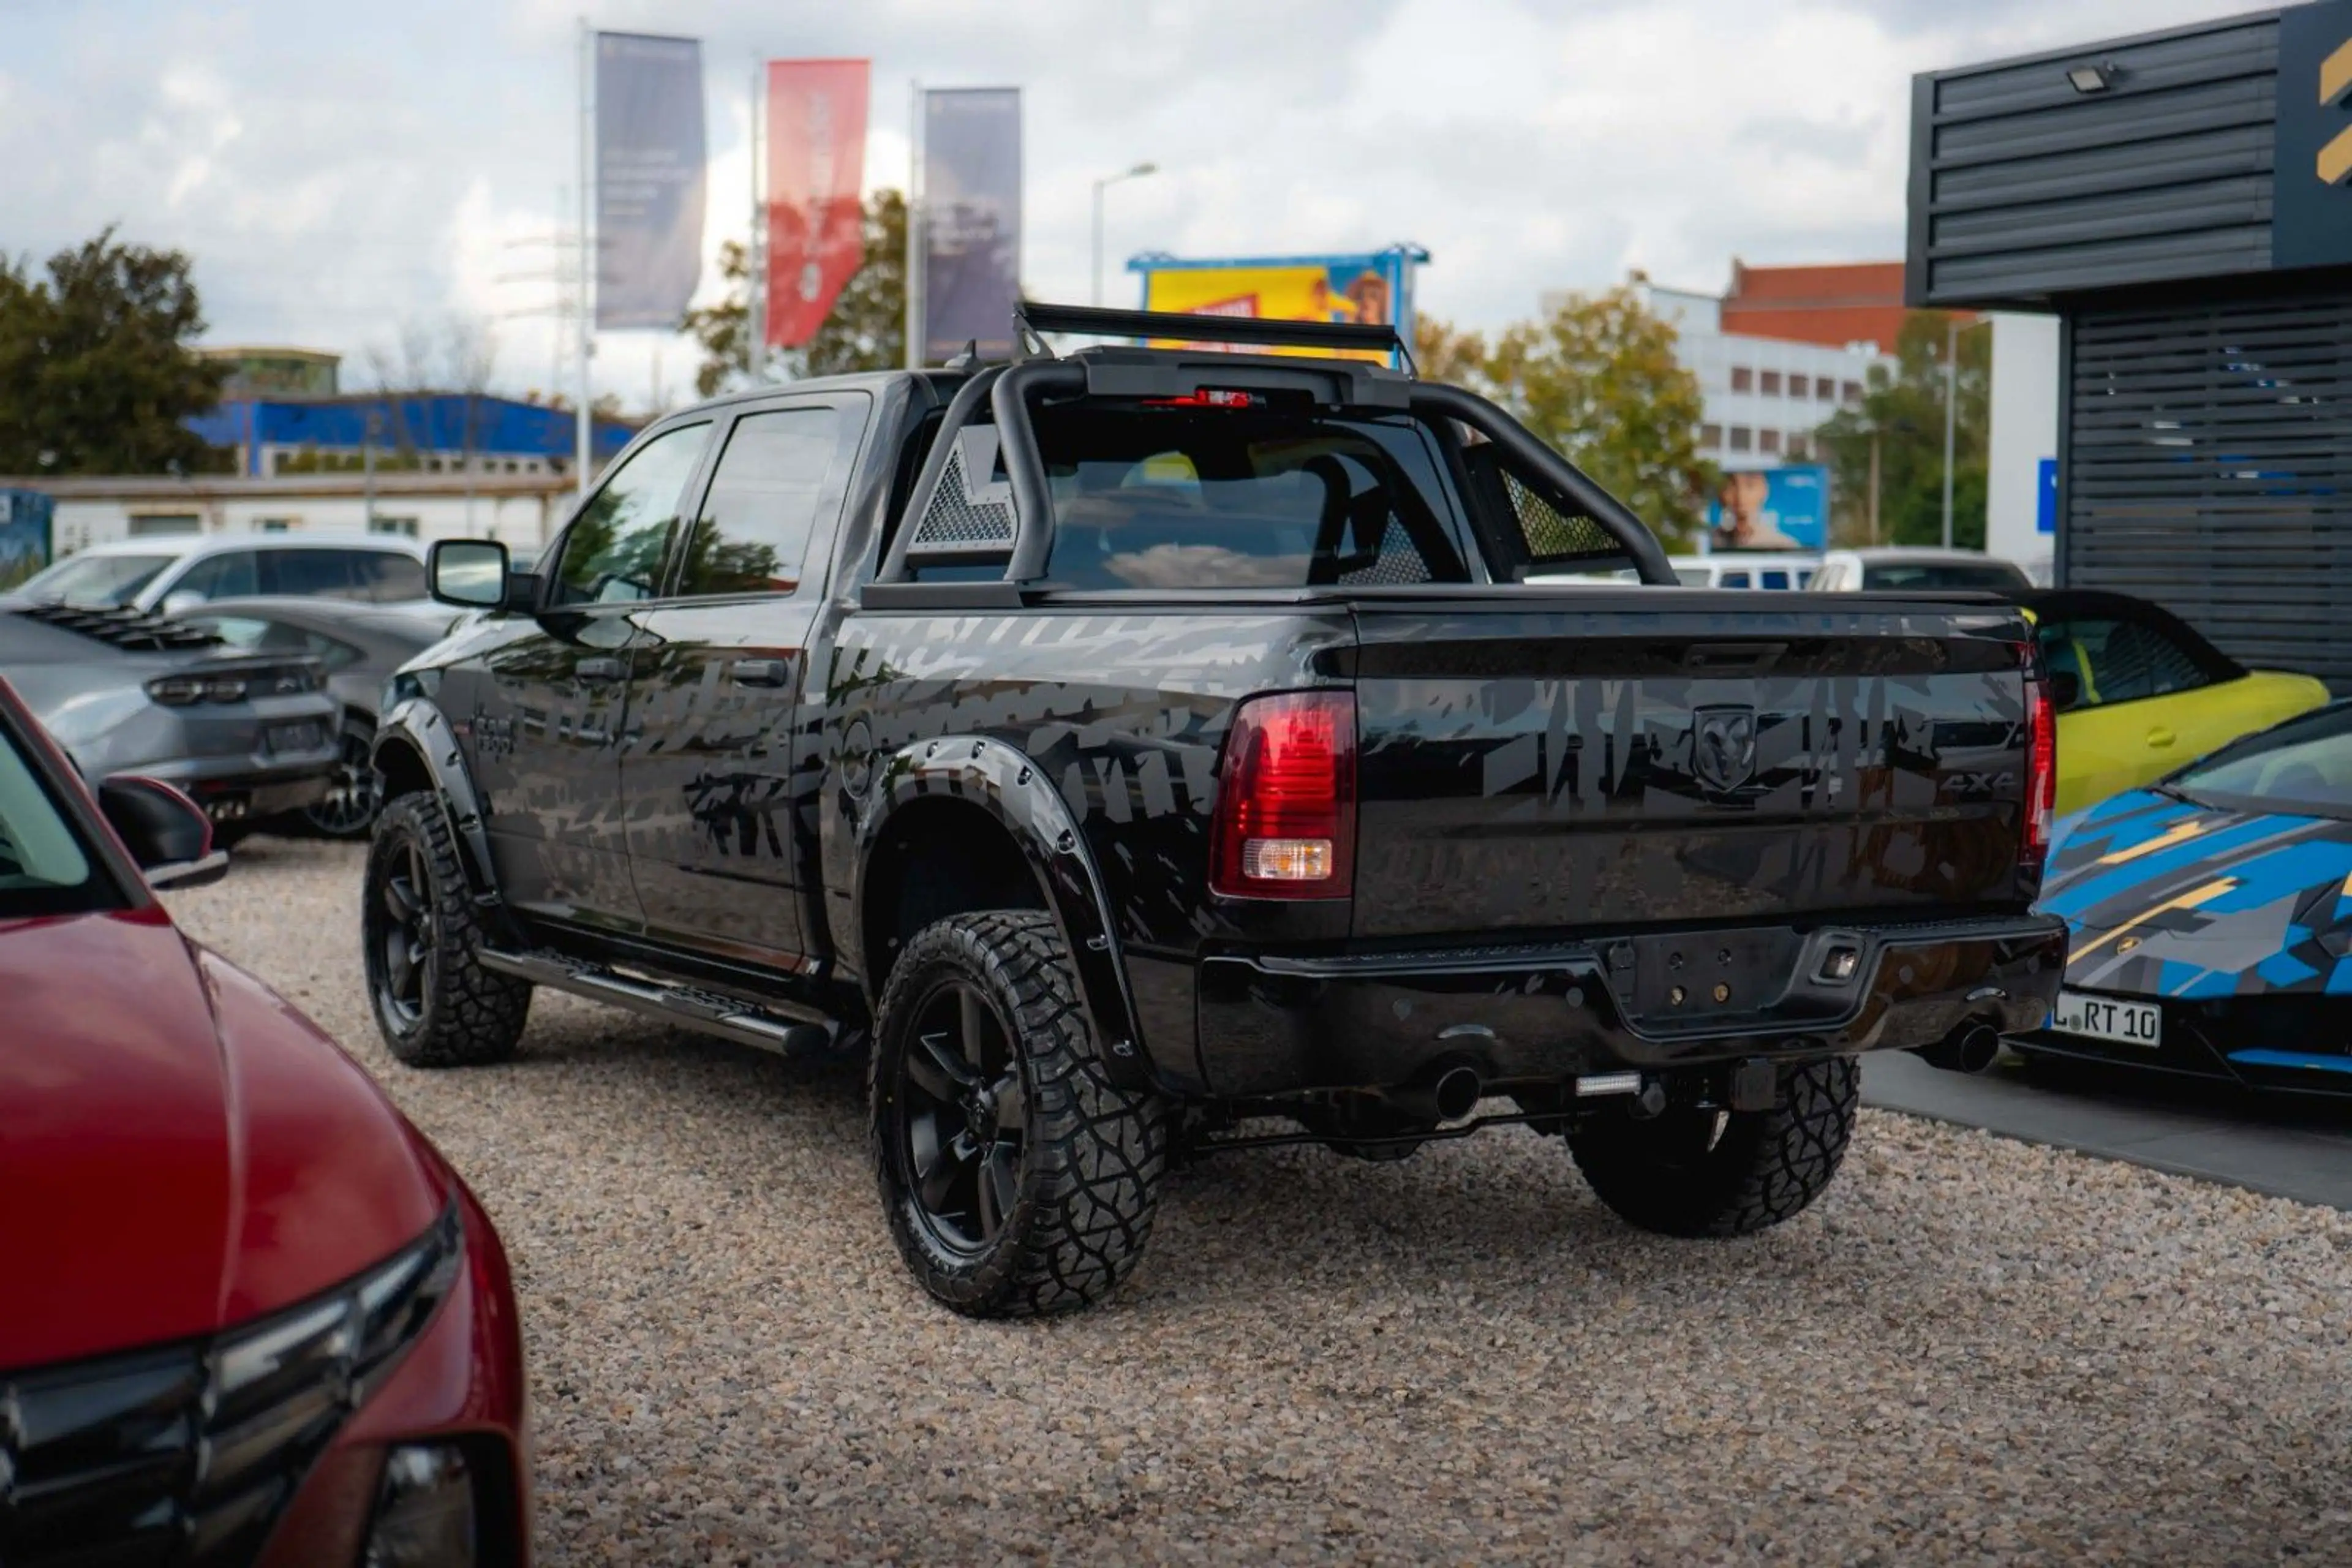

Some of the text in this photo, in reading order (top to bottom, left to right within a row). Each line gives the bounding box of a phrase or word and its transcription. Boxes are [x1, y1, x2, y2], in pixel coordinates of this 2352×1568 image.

[2054, 997, 2155, 1039] L RT 10
